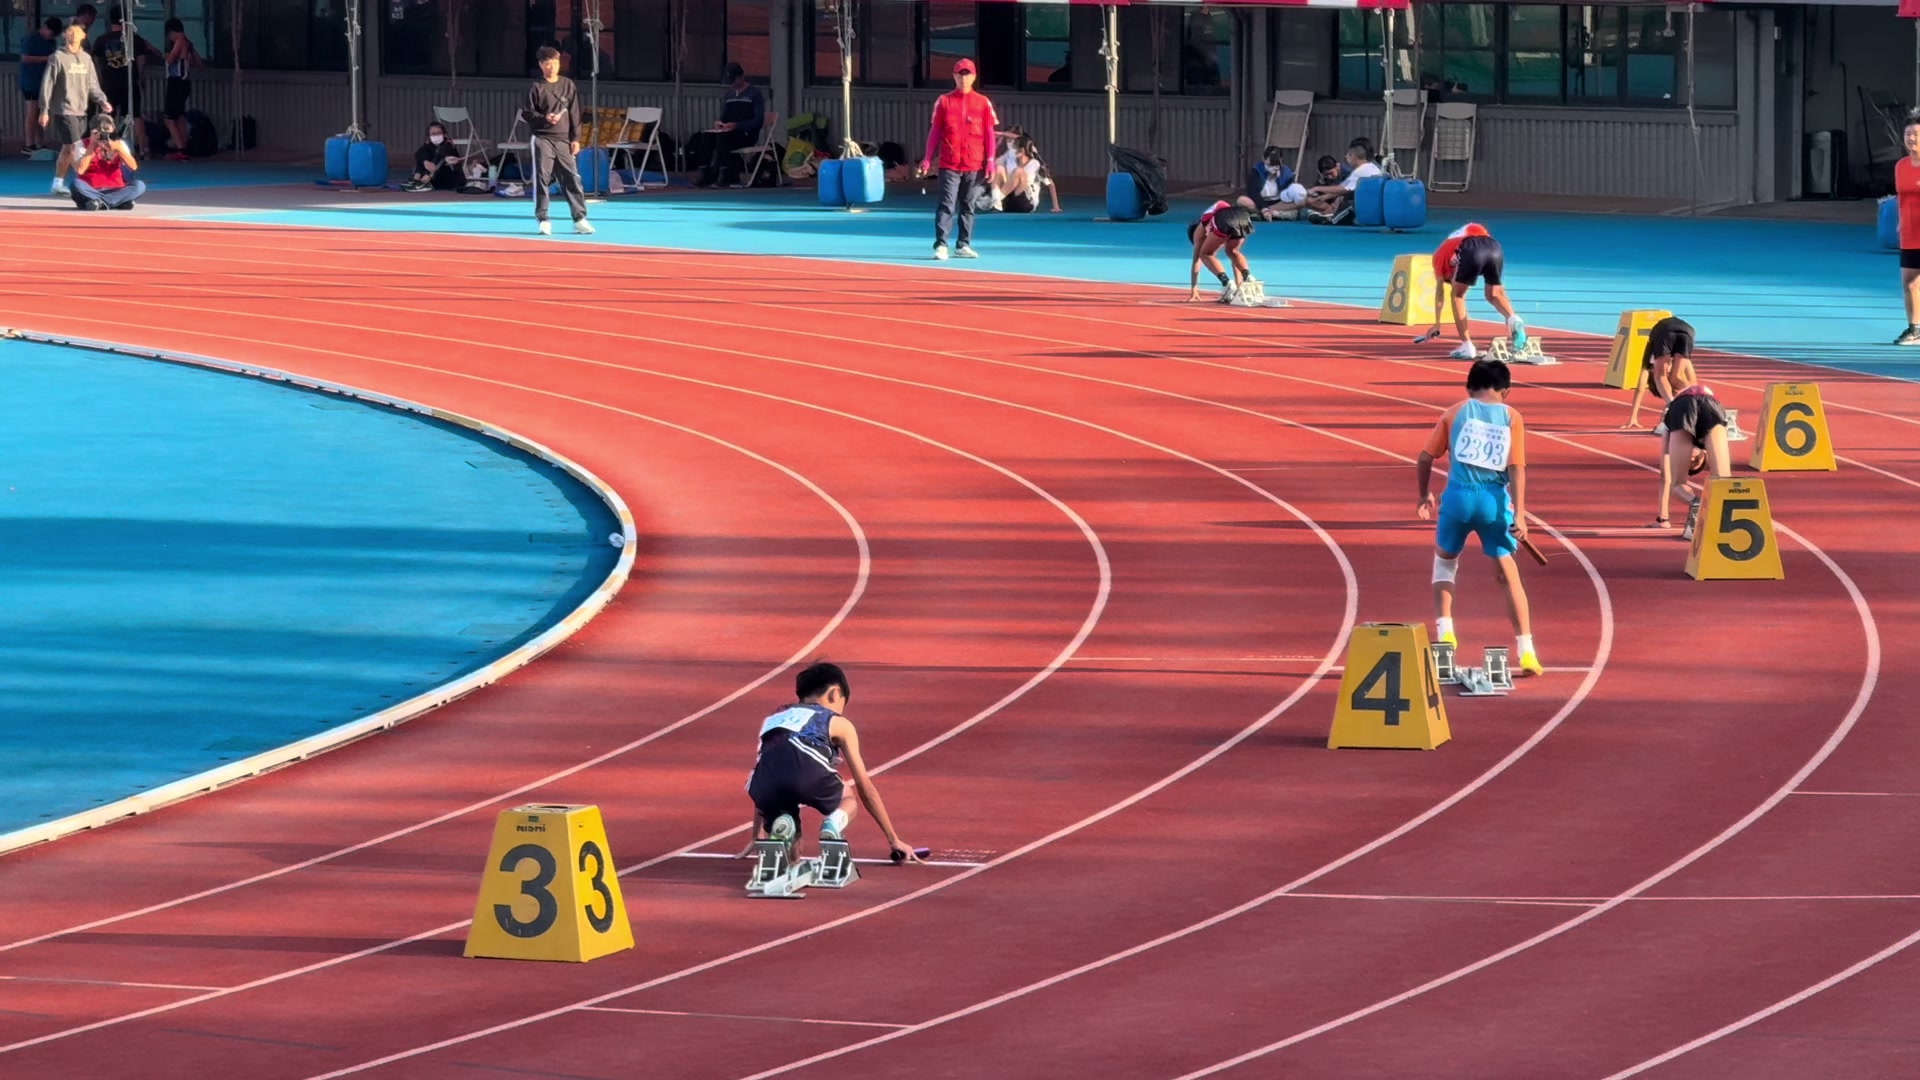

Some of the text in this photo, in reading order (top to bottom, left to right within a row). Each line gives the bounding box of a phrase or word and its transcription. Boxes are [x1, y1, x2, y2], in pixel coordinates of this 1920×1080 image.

[1388, 270, 1407, 313] 8
[1612, 326, 1630, 372] 7
[1457, 435, 1505, 466] 2393
[1774, 402, 1817, 457] 6
[1717, 499, 1765, 562] 5
[1351, 651, 1411, 726] 4
[1424, 647, 1441, 721] 4
[493, 843, 558, 938] 3
[578, 840, 614, 934] 3
